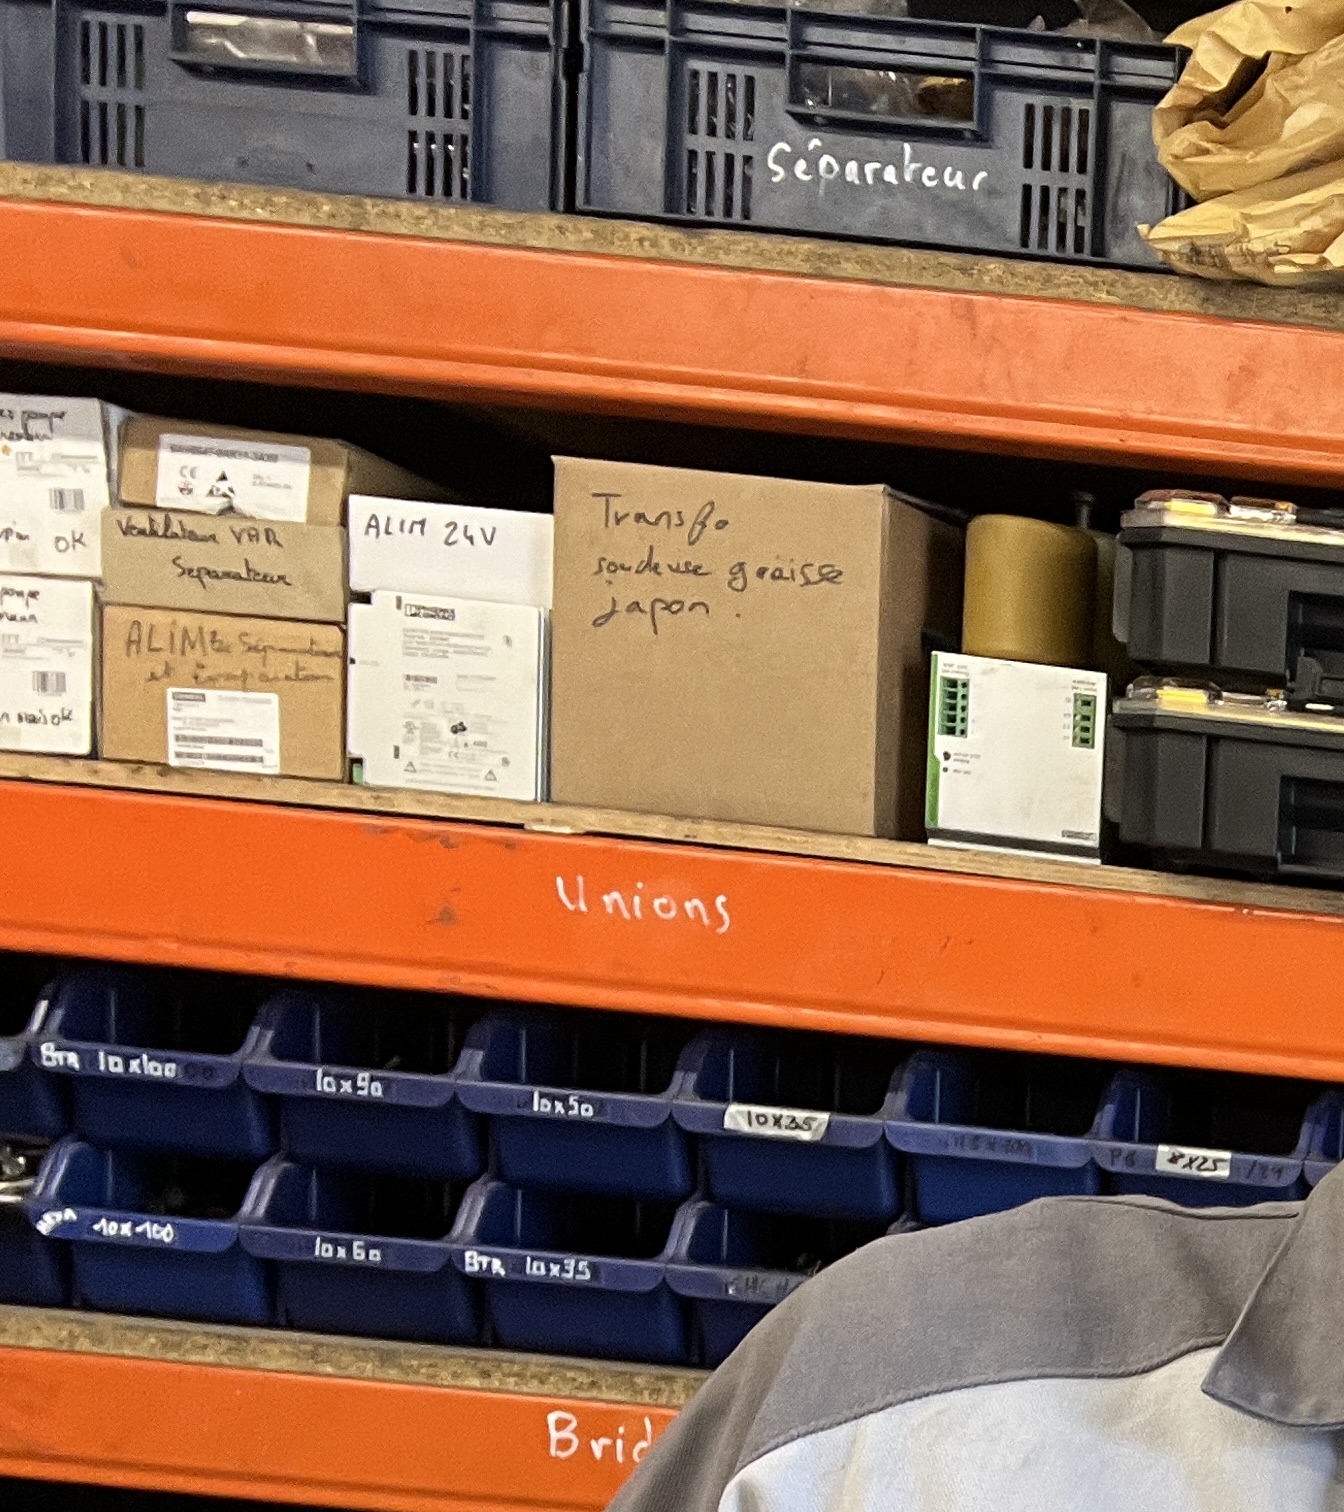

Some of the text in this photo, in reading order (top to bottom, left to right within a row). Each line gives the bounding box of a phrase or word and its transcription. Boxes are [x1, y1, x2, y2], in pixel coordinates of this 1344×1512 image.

[364, 514, 497, 548] ALIM 24V
[592, 493, 729, 547] Transfo
[556, 876, 732, 935] Unions
[547, 1410, 652, 1463] Brid
